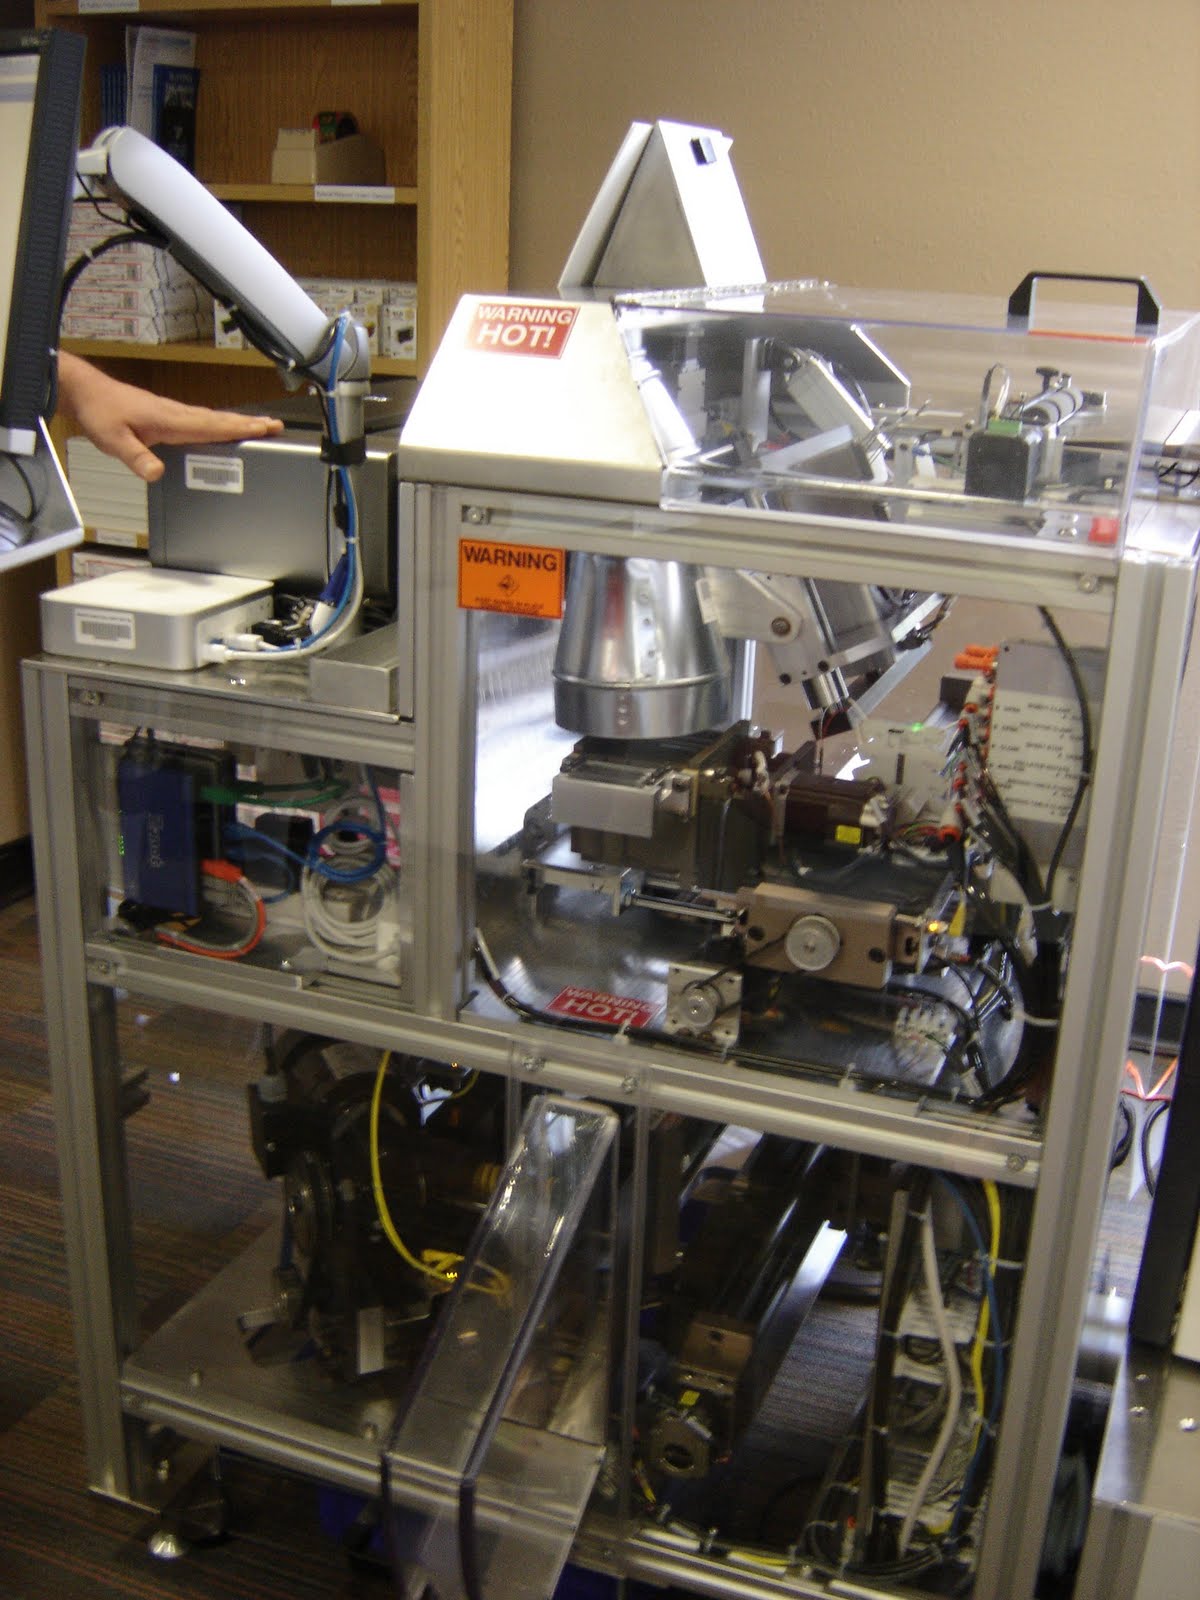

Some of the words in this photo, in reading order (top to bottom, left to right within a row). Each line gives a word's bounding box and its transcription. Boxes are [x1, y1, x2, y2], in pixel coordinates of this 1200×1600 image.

[479, 305, 573, 325] WARNING
[476, 323, 556, 348] HOT!
[464, 545, 557, 571] WARNING
[566, 988, 656, 1012] WARNING
